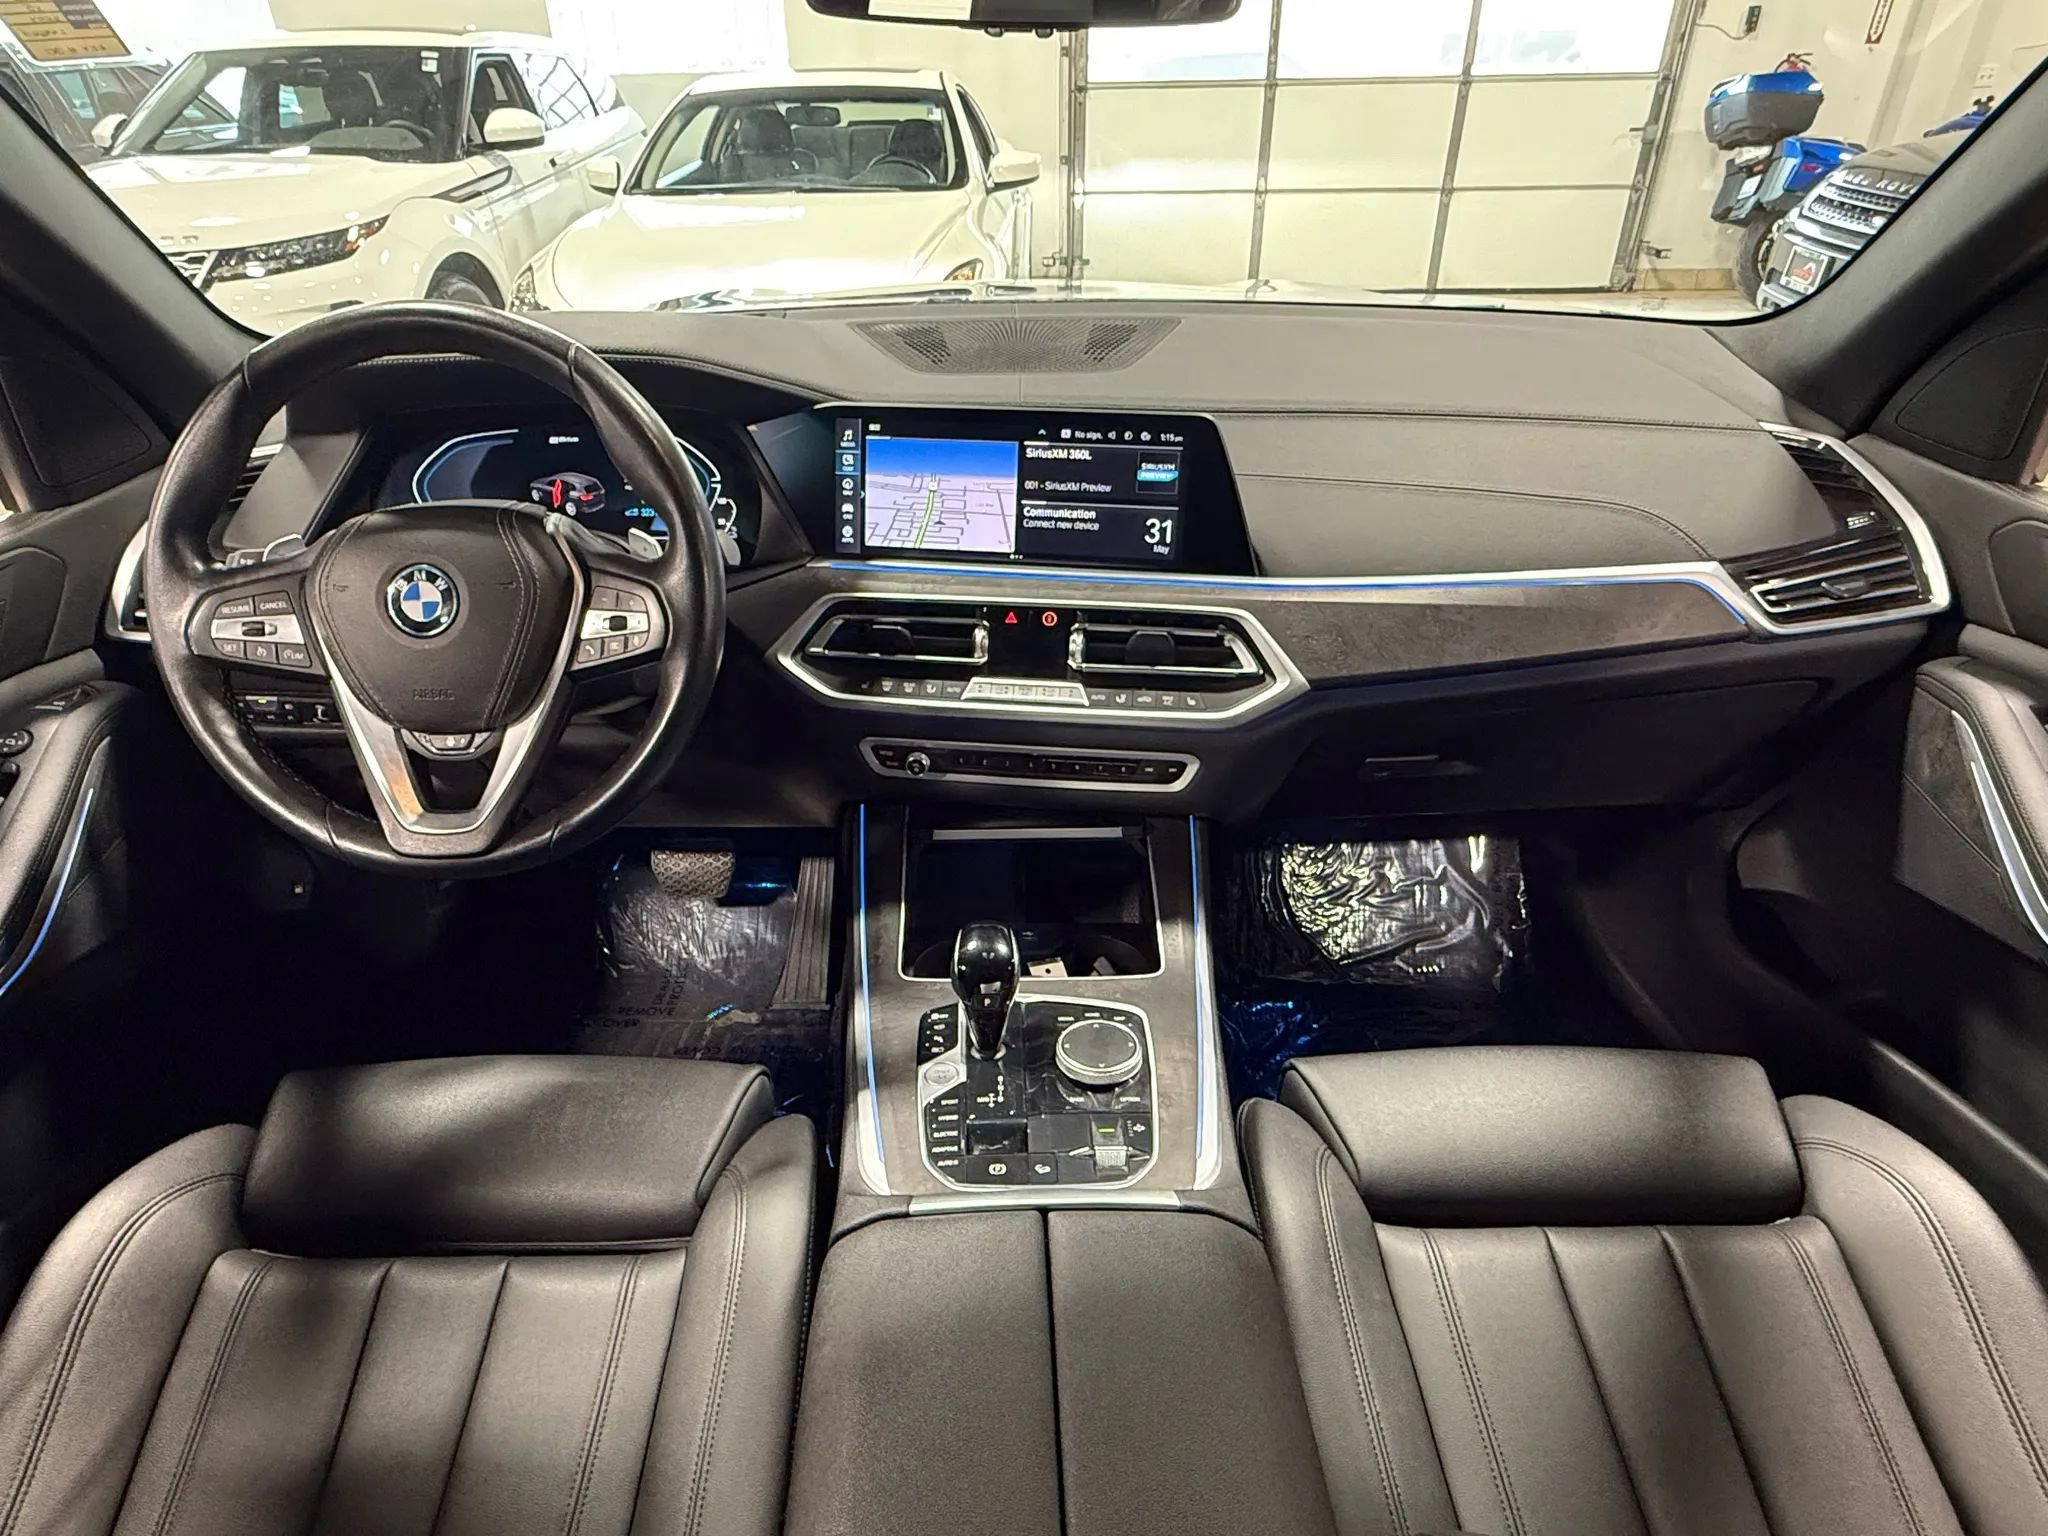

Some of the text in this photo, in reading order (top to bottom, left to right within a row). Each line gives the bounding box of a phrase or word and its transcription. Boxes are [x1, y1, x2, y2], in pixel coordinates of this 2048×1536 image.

[1025, 447, 1092, 460] SiriusXM 360L
[1024, 480, 1038, 490] 001
[1045, 481, 1080, 492] SiriusXM
[1081, 482, 1112, 493] Preview
[1023, 506, 1096, 519] Communication
[1023, 518, 1100, 531] Connect new device
[1144, 518, 1173, 545] 31
[1153, 544, 1170, 555] May
[394, 570, 448, 592] BMW
[221, 604, 250, 614] RESUME
[260, 601, 288, 611] CANCEL
[223, 643, 237, 652] SET
[984, 998, 991, 1007] P
[933, 1130, 959, 1138] ELECTRIC
[931, 1145, 959, 1153] ADAPTIVE
